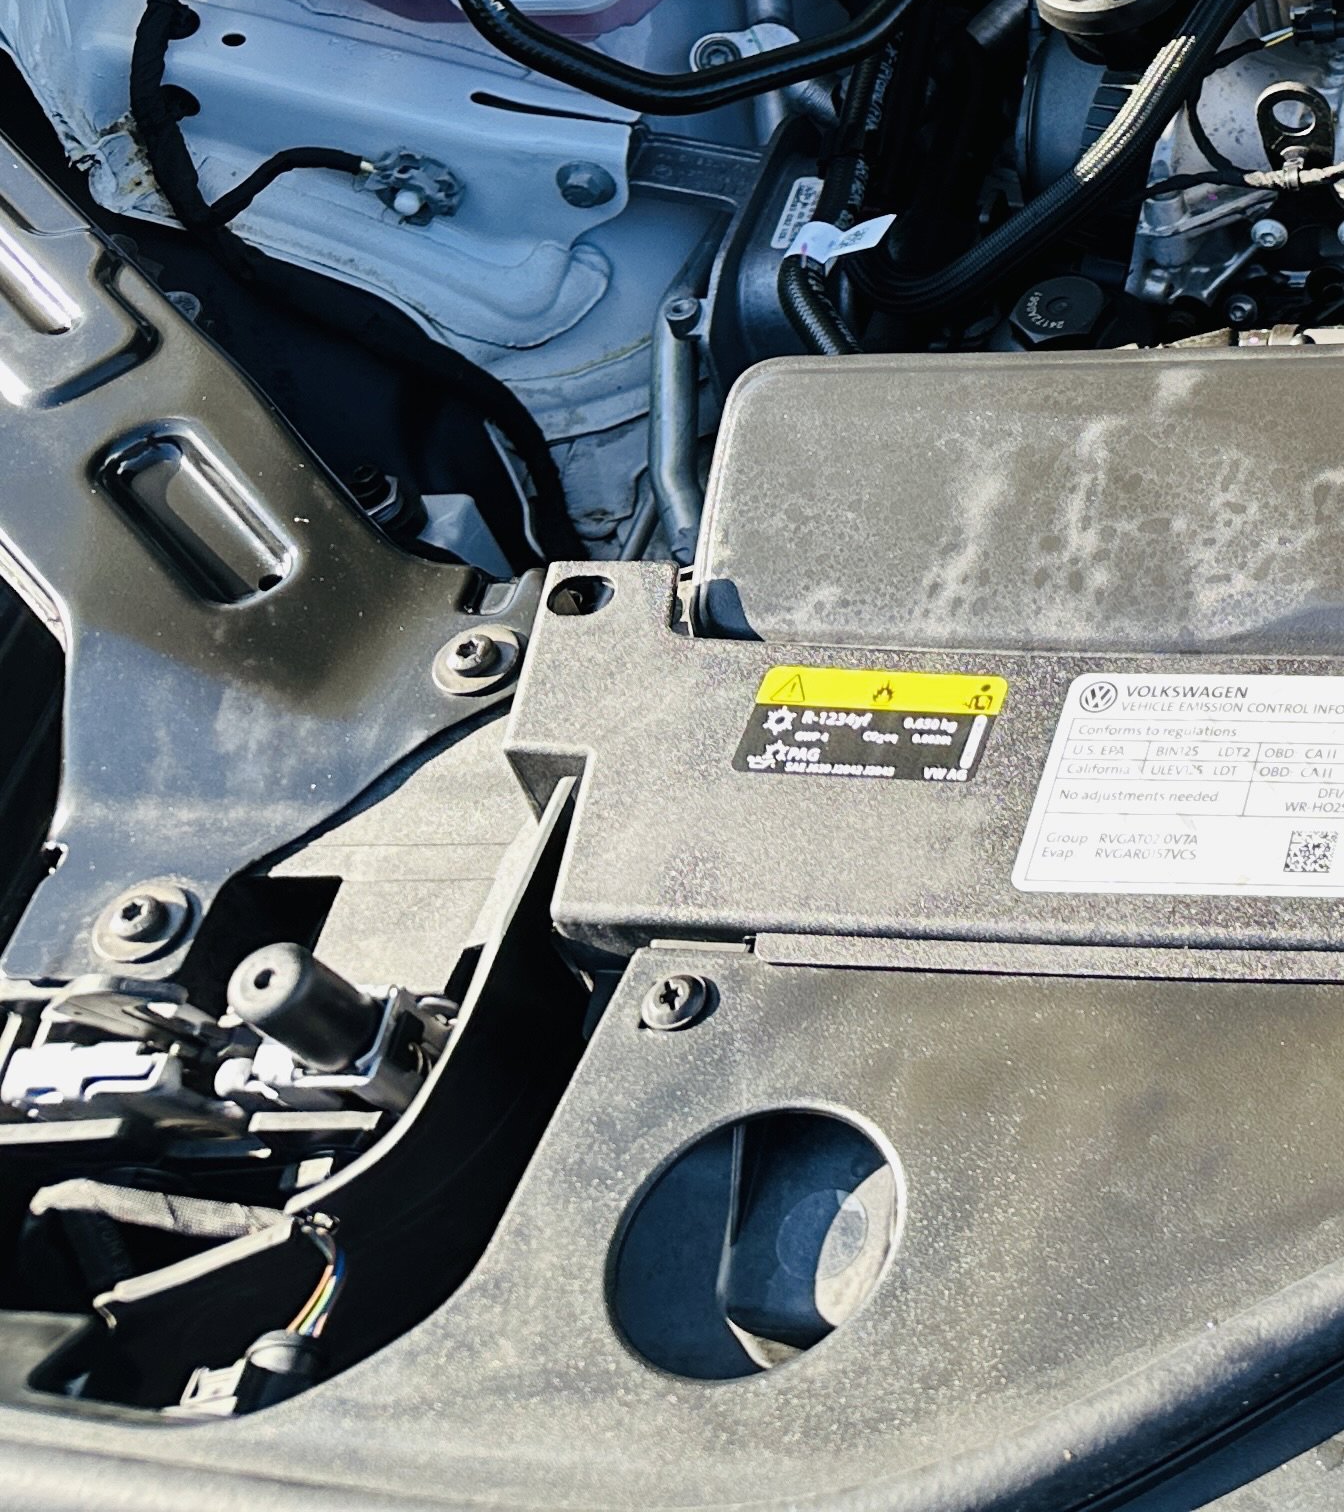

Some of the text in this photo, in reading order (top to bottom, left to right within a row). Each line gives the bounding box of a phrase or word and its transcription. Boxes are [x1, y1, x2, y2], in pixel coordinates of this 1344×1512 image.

[1126, 685, 1248, 699] VOLKSWAGEN
[1122, 702, 1174, 712] VEHICLE
[1179, 702, 1243, 712] EMISSION
[1248, 703, 1308, 714] CONTROL
[1078, 724, 1237, 739] Conforms to regulations
[787, 747, 821, 761] PAG
[1101, 746, 1124, 755] EPA
[1156, 746, 1251, 757] BIN125 LDT2
[1067, 763, 1130, 775] California
[1213, 766, 1237, 776] LDT
[1060, 789, 1219, 803] No adjustments needed
